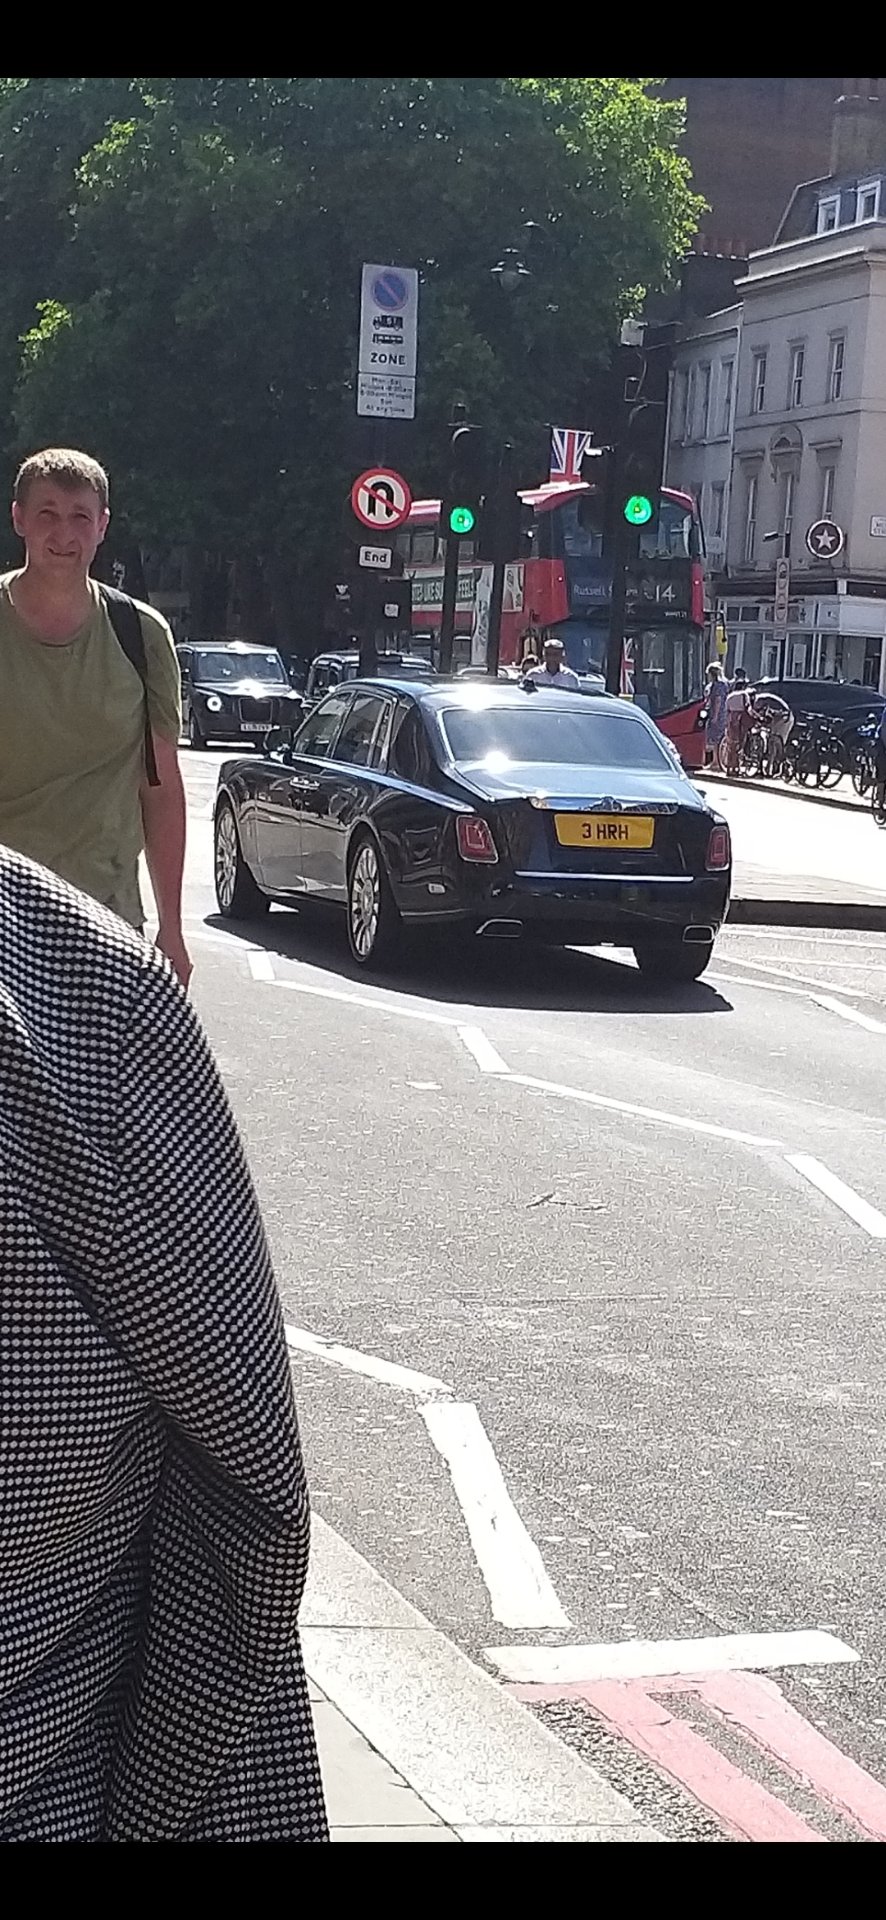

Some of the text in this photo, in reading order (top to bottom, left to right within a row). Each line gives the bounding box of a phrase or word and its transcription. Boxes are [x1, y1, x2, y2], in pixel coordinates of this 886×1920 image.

[370, 352, 405, 365] ZONE
[364, 551, 387, 562] End
[655, 583, 677, 603] 14
[582, 823, 628, 840] 3 HRH
